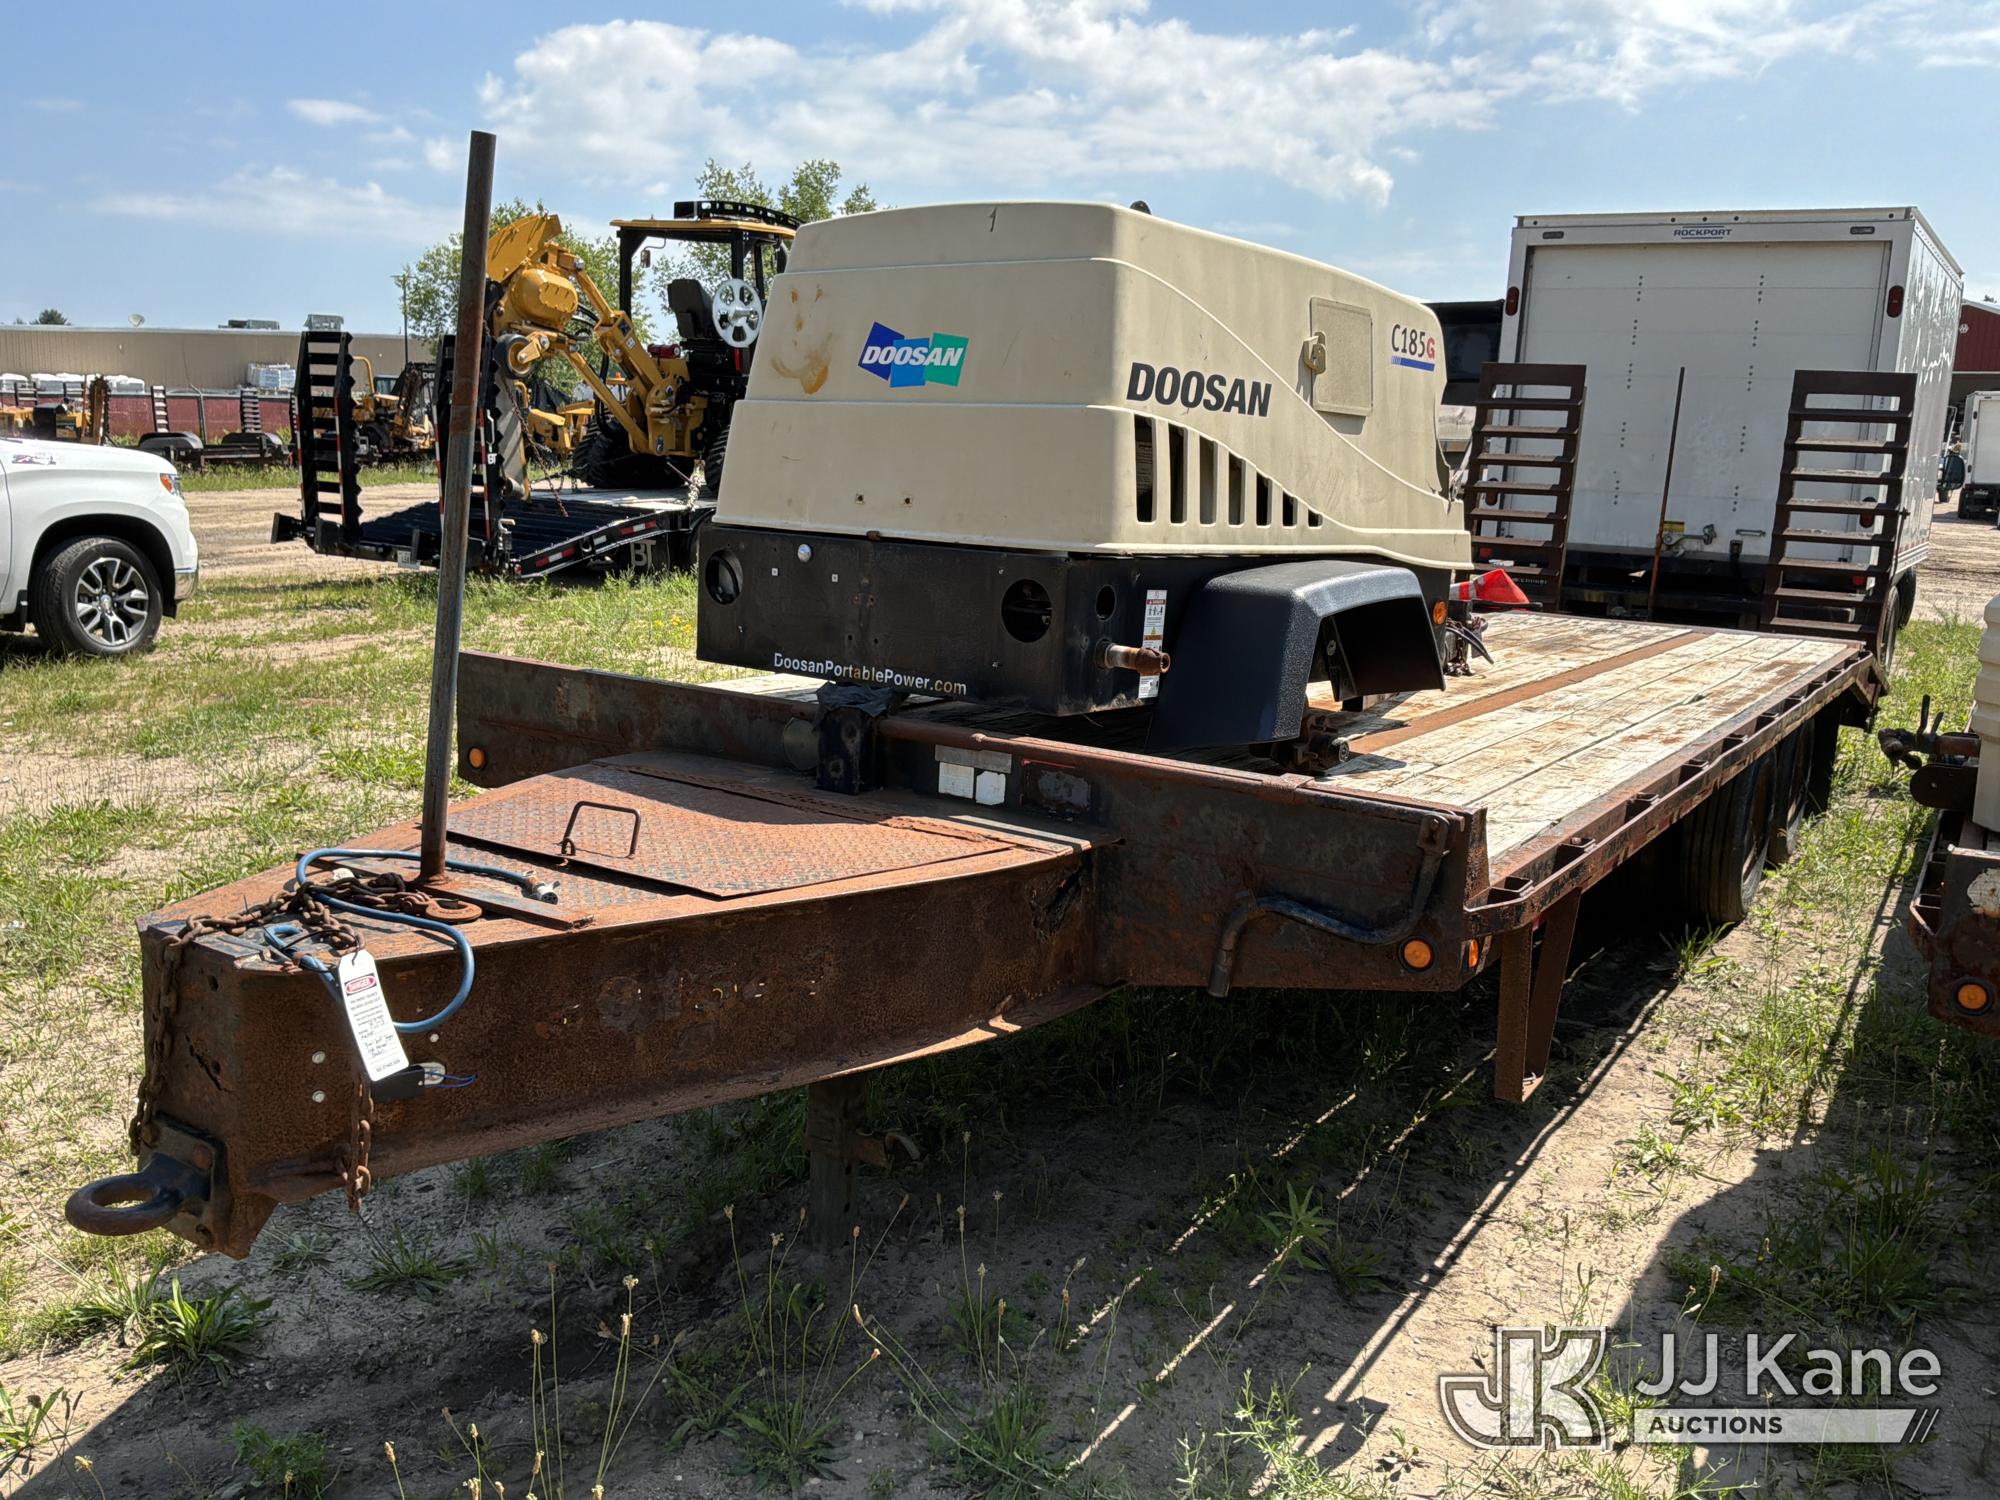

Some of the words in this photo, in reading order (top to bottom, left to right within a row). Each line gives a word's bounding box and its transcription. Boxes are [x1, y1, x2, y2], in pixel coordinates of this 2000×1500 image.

[1673, 229, 1732, 237] ROCKPORT
[862, 345, 964, 367] DOOSAN
[1391, 323, 1436, 360] C185G
[1126, 362, 1272, 417] DOOSAN
[773, 652, 967, 696] DoosanPortablePower.com
